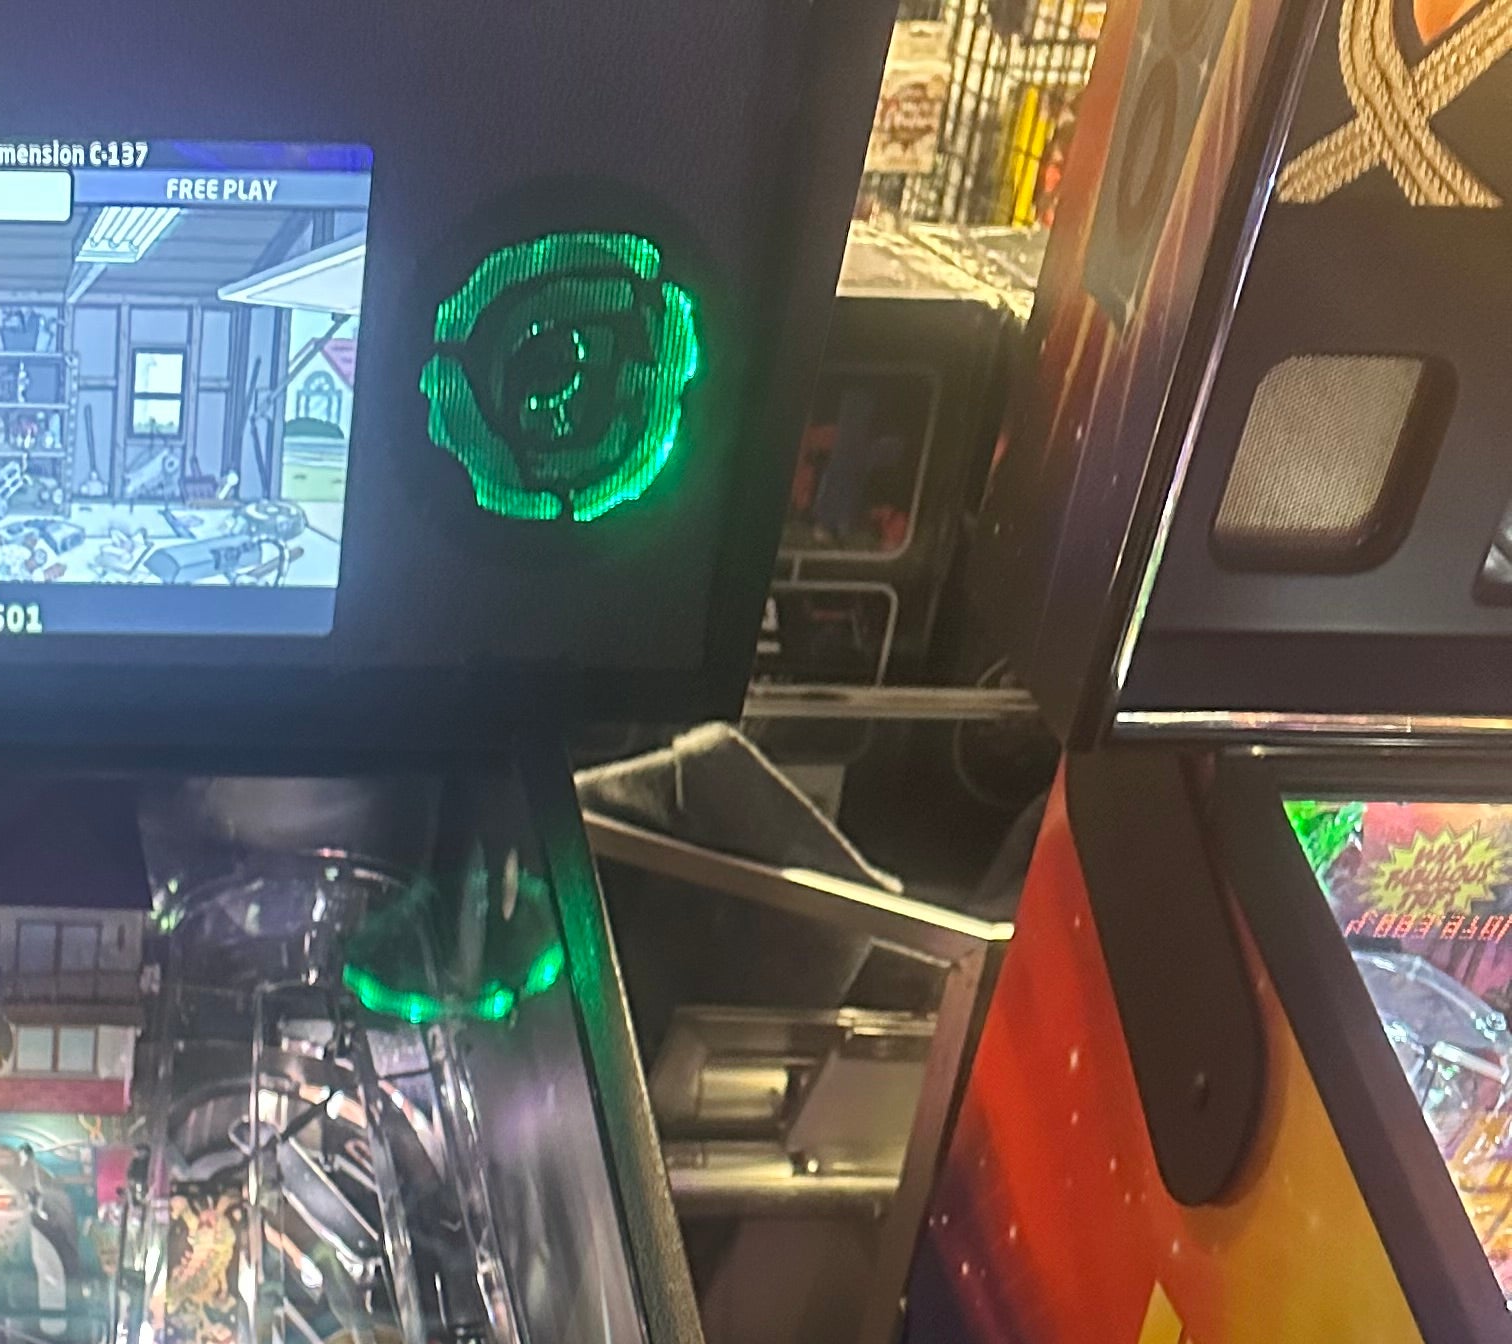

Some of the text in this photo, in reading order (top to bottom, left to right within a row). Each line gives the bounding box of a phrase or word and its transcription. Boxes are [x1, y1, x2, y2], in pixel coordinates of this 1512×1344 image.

[89, 141, 149, 168] C-137
[167, 178, 277, 202] FREE PLAY
